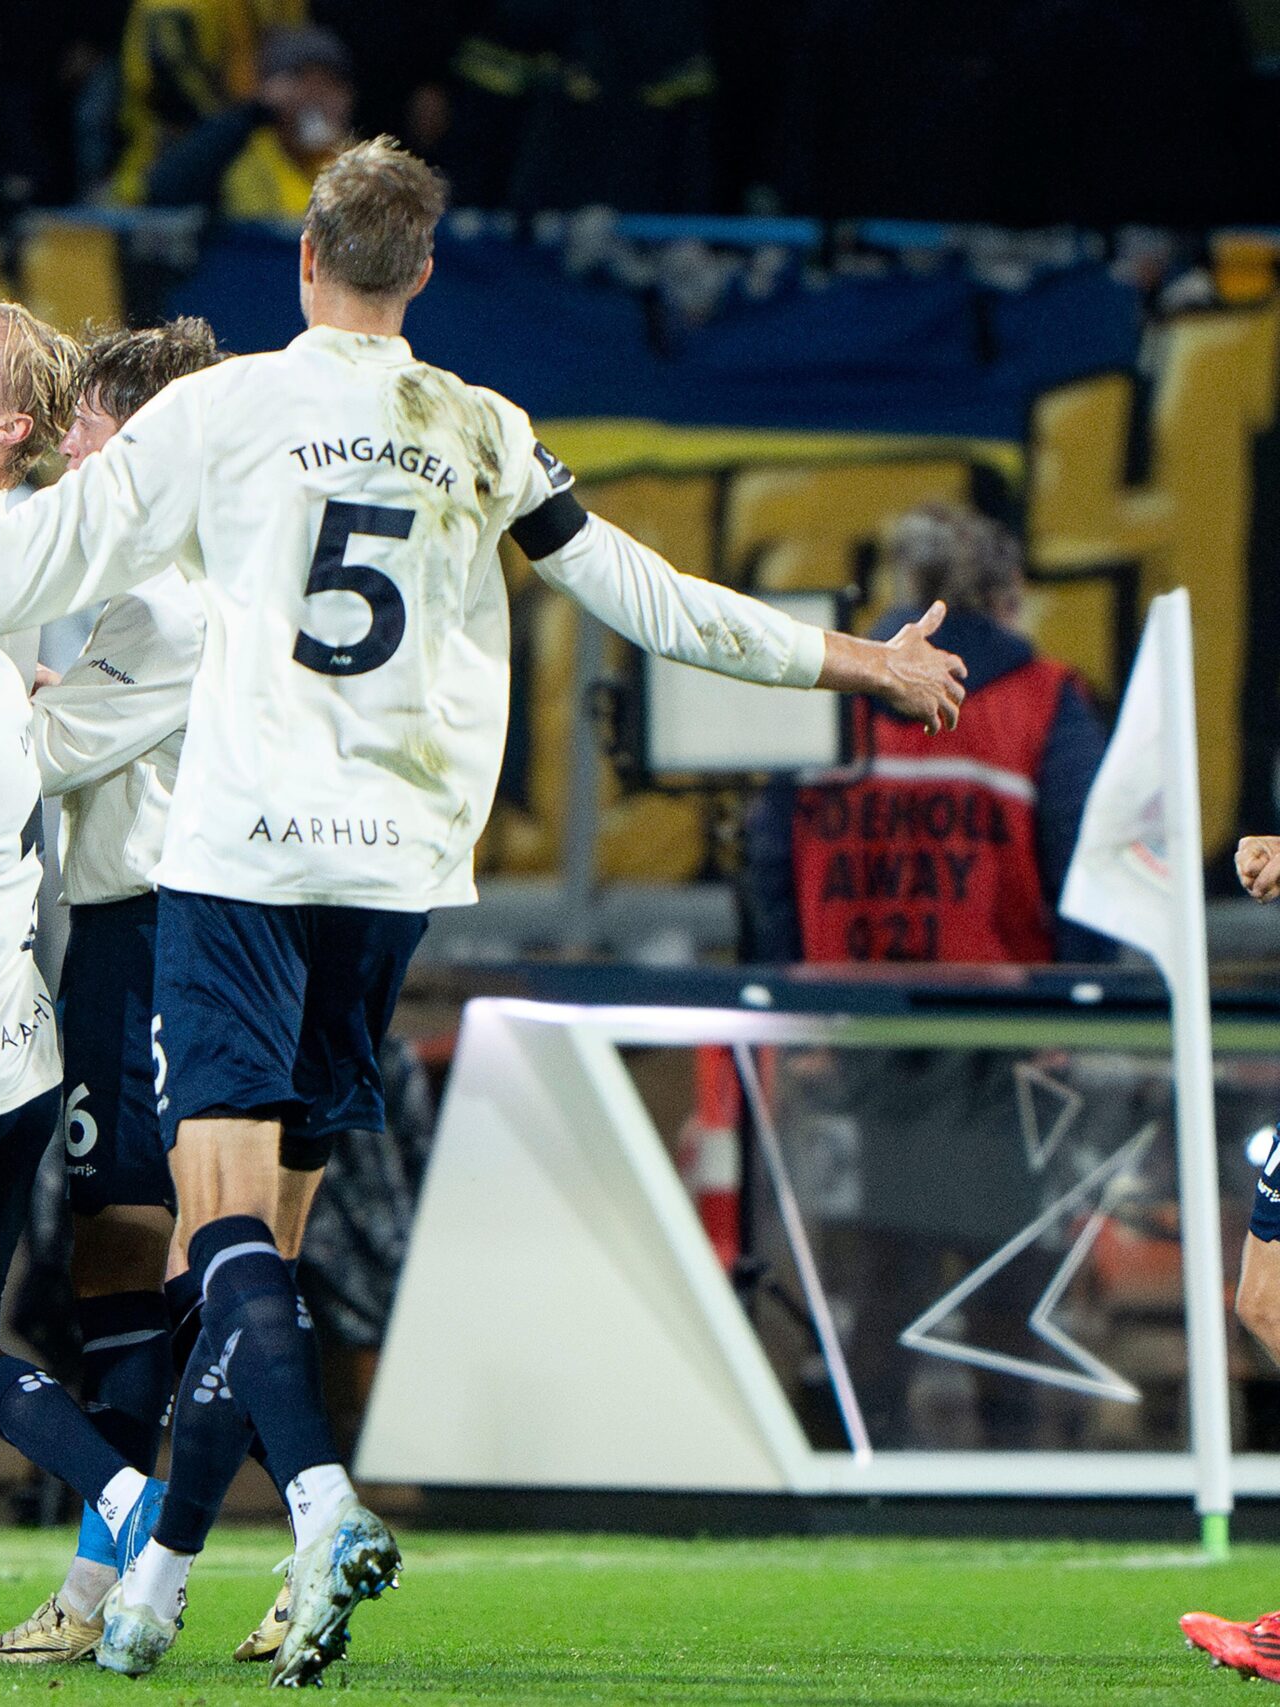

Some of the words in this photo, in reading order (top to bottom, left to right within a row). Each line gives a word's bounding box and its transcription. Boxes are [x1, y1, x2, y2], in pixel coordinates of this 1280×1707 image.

[289, 437, 458, 494] TINGAGER
[292, 498, 417, 677] 5
[248, 814, 400, 846] AARHUS
[821, 850, 977, 903] AWAY
[64, 1081, 98, 1158] 6
